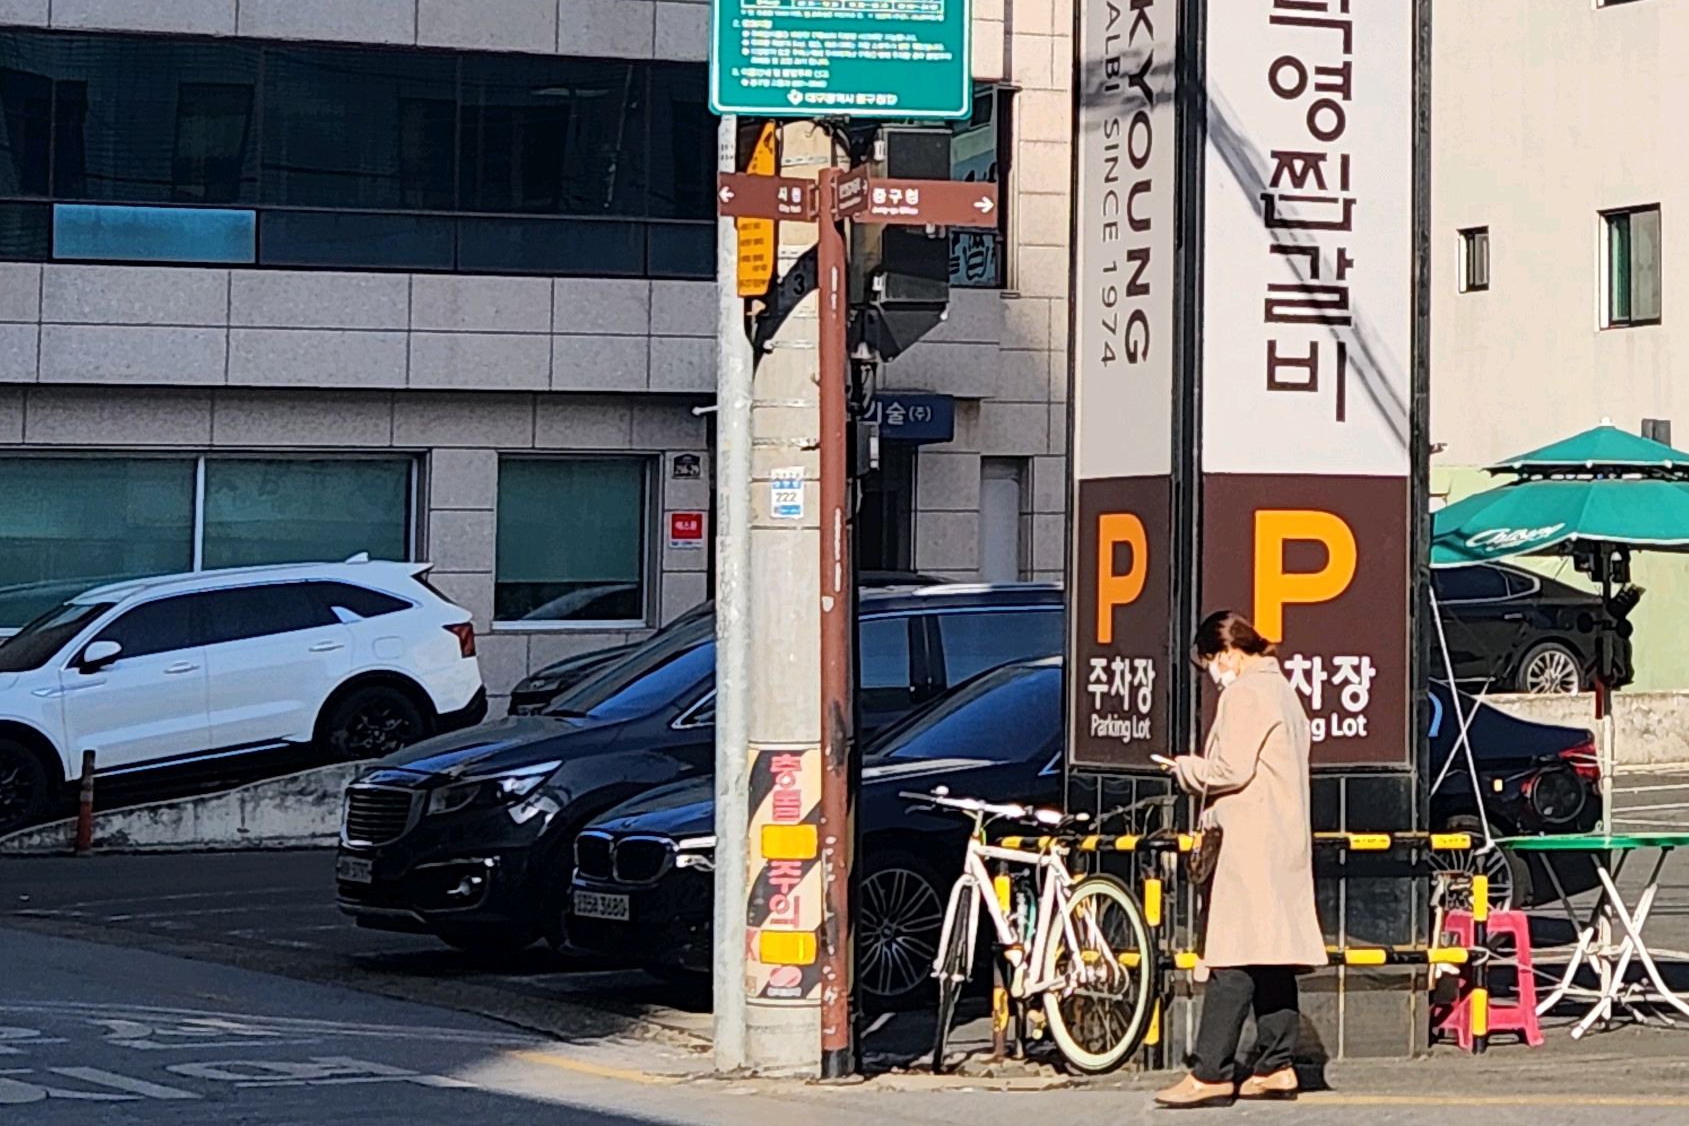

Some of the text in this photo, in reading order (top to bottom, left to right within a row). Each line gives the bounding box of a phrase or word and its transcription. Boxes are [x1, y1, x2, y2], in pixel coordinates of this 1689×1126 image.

[1101, 117, 1120, 244] SINCE
[1100, 260, 1118, 368] 1974
[775, 491, 798, 503] 222
[1097, 513, 1148, 644] P
[1254, 509, 1358, 644] P
[1087, 656, 1156, 714] 주차장
[1284, 654, 1377, 713] 차장
[1091, 713, 1152, 743] Parking Lot
[1331, 713, 1368, 738] Lot
